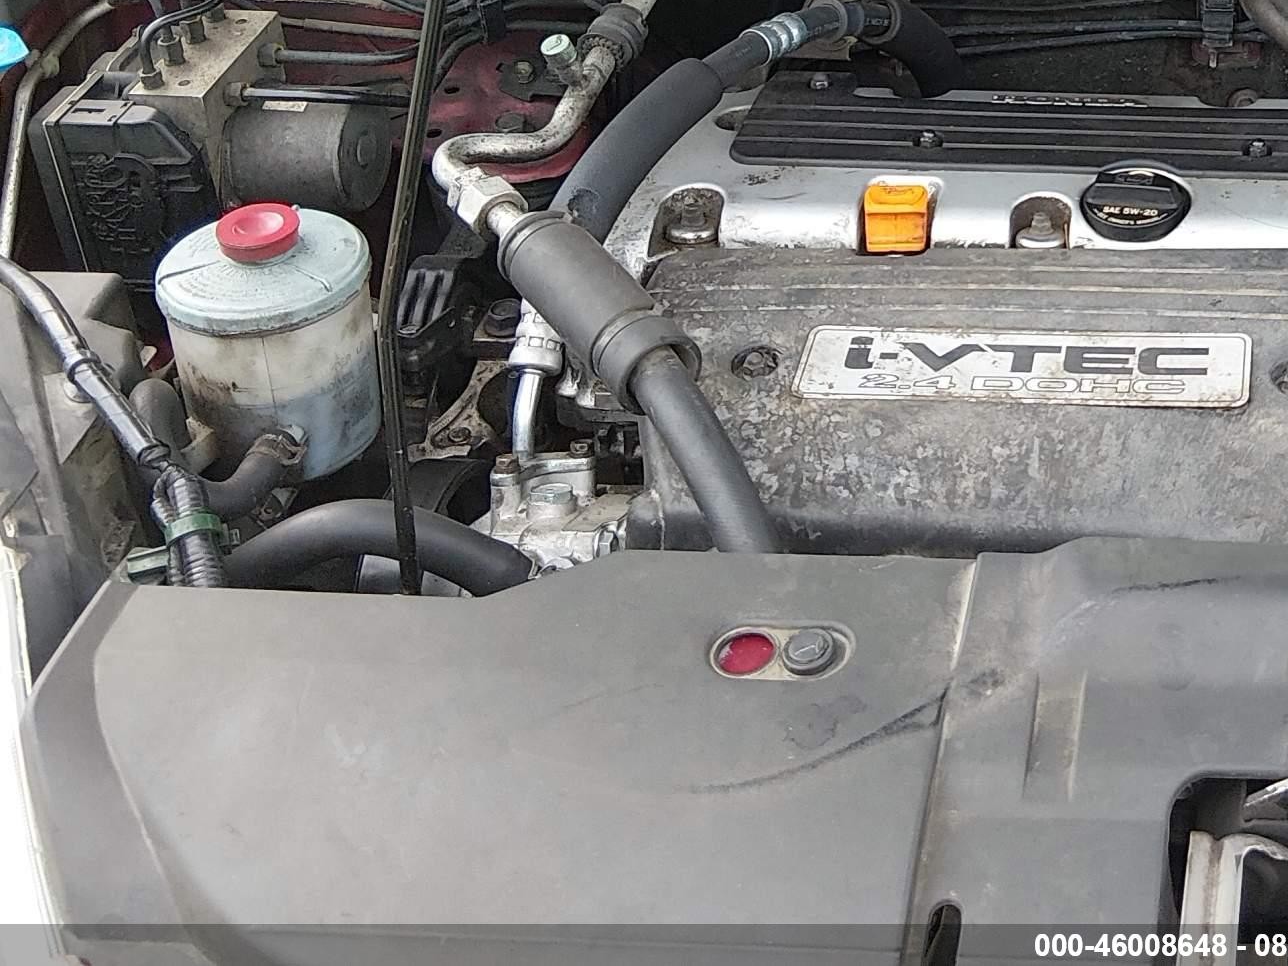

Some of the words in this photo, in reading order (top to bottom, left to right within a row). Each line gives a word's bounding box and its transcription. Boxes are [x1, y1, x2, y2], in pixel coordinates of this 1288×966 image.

[1102, 205, 1121, 215] SAE
[844, 336, 1210, 375] i-VTEC
[858, 373, 956, 391] 2.4
[970, 376, 1187, 394] DOHC
